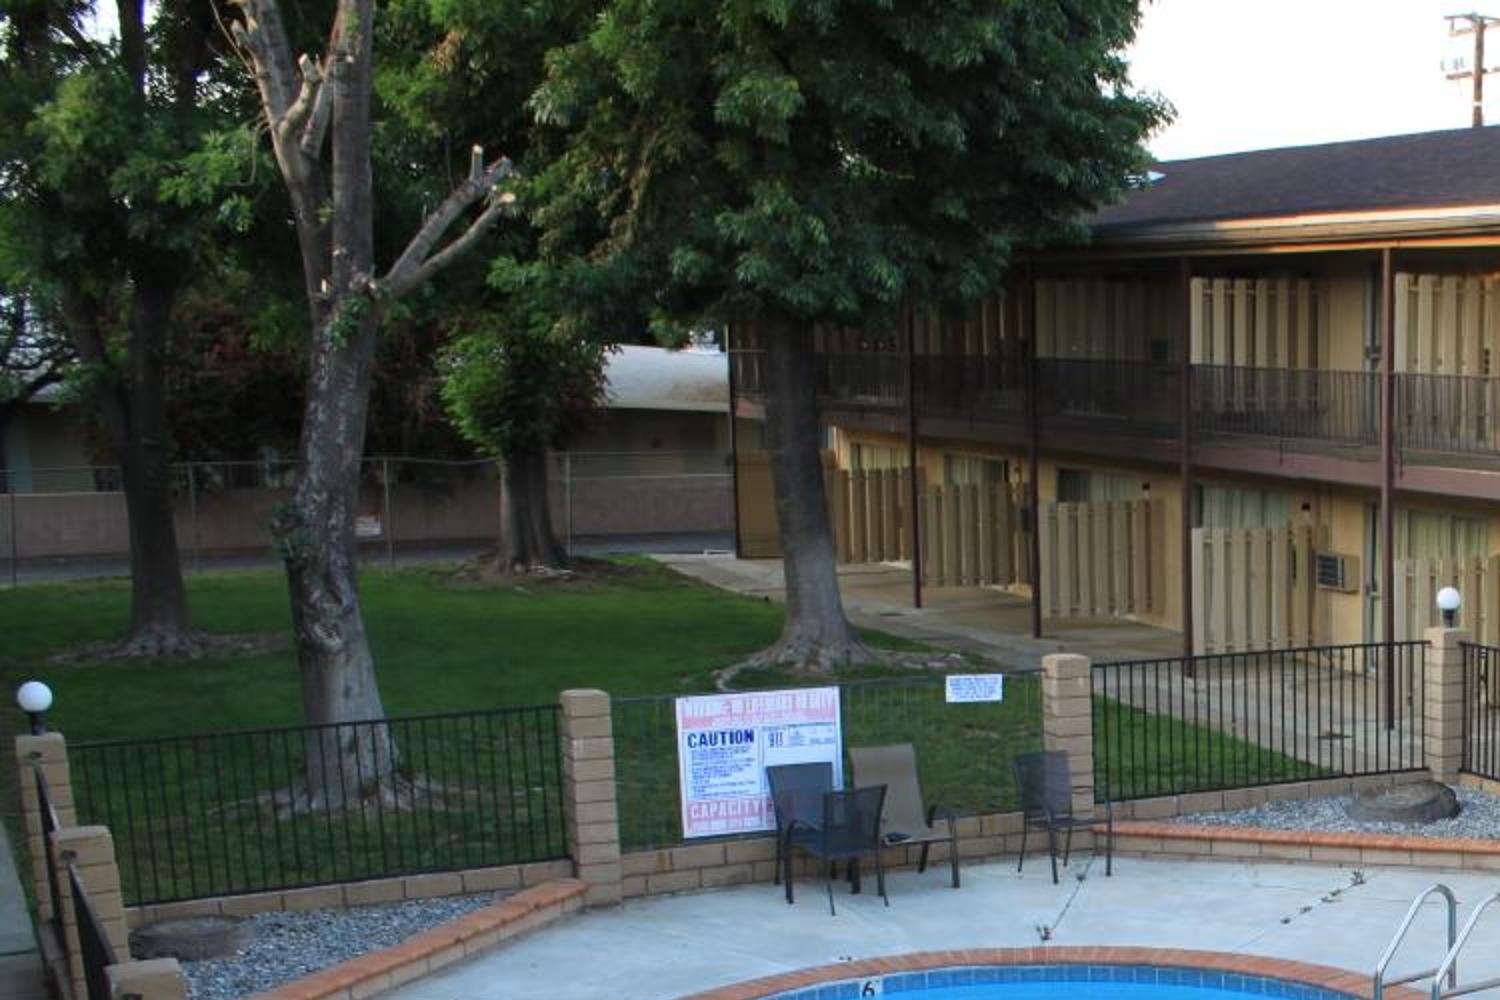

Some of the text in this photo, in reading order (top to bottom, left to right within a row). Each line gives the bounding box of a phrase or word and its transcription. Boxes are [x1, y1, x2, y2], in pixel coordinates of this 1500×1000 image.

[687, 729, 755, 748] CAUTION
[690, 798, 761, 819] CAPACITY
[861, 980, 876, 998] 6
